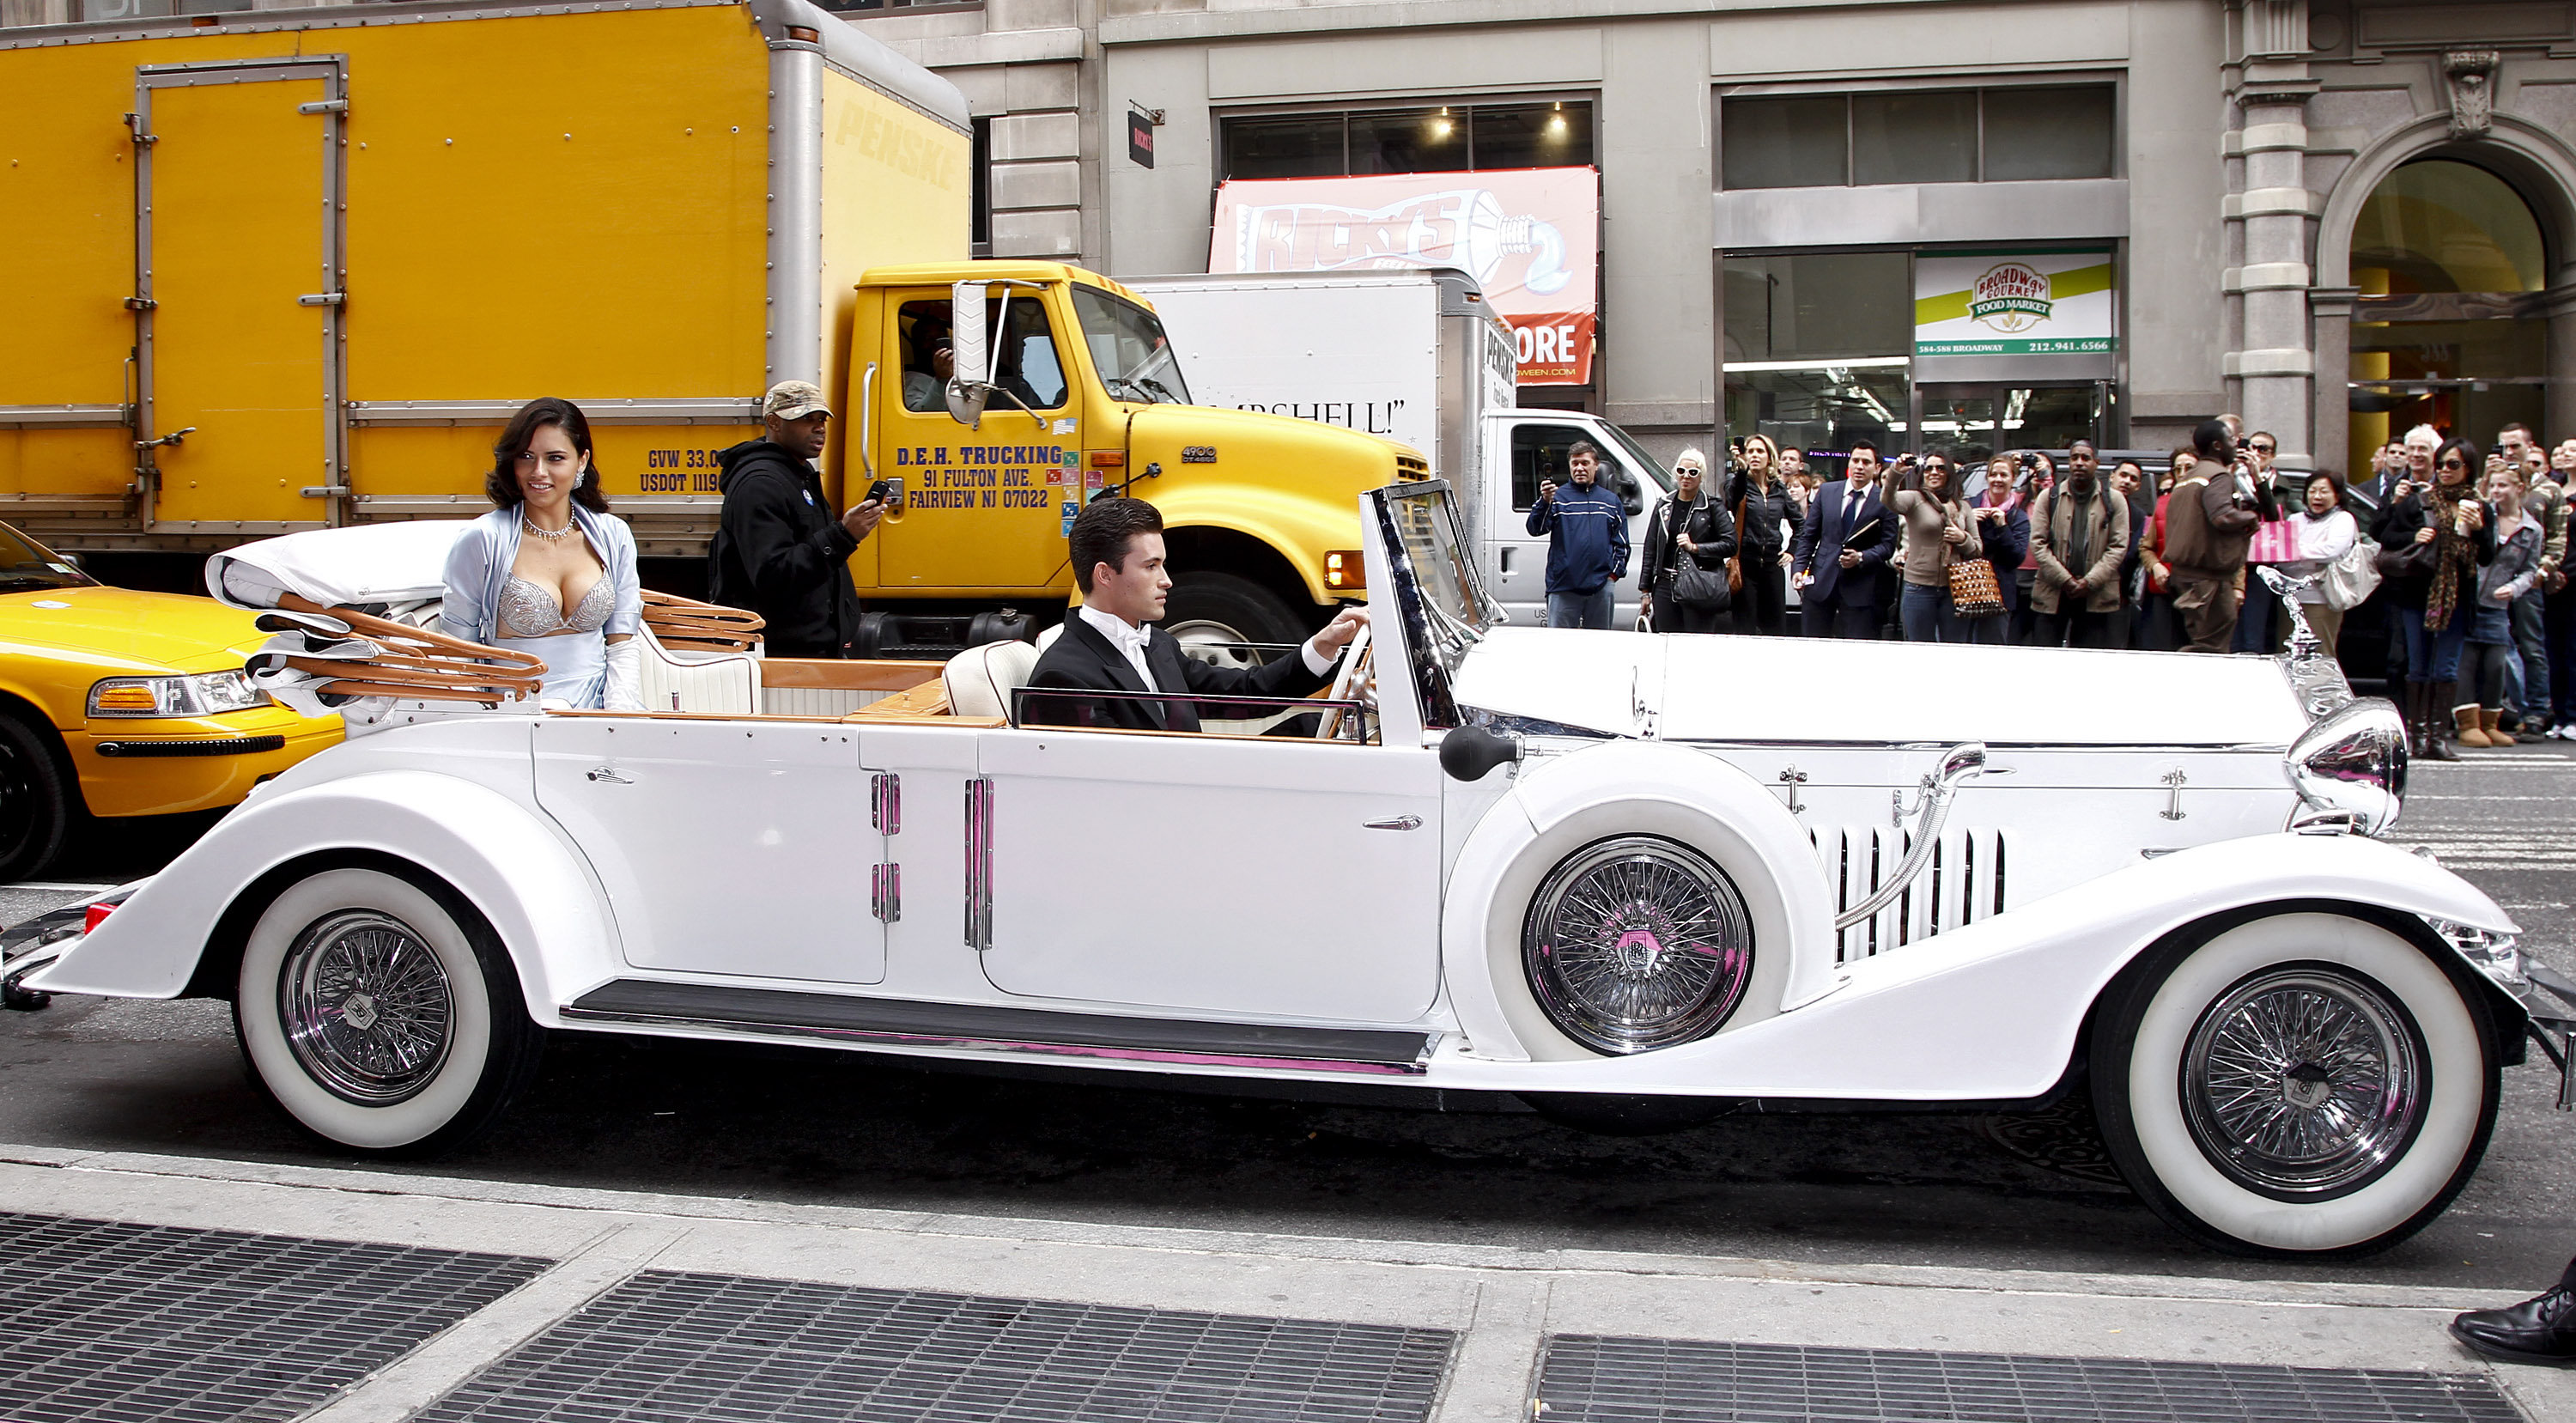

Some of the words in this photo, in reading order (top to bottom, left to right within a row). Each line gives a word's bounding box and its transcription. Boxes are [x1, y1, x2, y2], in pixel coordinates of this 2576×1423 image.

[835, 99, 956, 191] PENSKE
[1255, 196, 1461, 271] RICKY'S
[1979, 268, 2045, 295] BROADWAY
[1987, 285, 2037, 298] GOURMET
[1977, 301, 2005, 313] FOOD
[2007, 299, 2049, 313] MARKET
[2029, 342, 2108, 351] 212.941.6566
[1486, 330, 1514, 386] PENSKE
[648, 449, 681, 468] GVW
[896, 447, 952, 465] D.E.H.
[960, 446, 1062, 465] TRUCKING
[1182, 446, 1216, 456] 4900
[640, 473, 687, 492] USDOT
[924, 470, 937, 487] 91
[944, 470, 996, 487] FULTON
[1003, 469, 1033, 486] AVE.
[909, 490, 975, 508] FAIRVIEW
[981, 490, 997, 508] NJ
[1003, 490, 1048, 508] 07022
